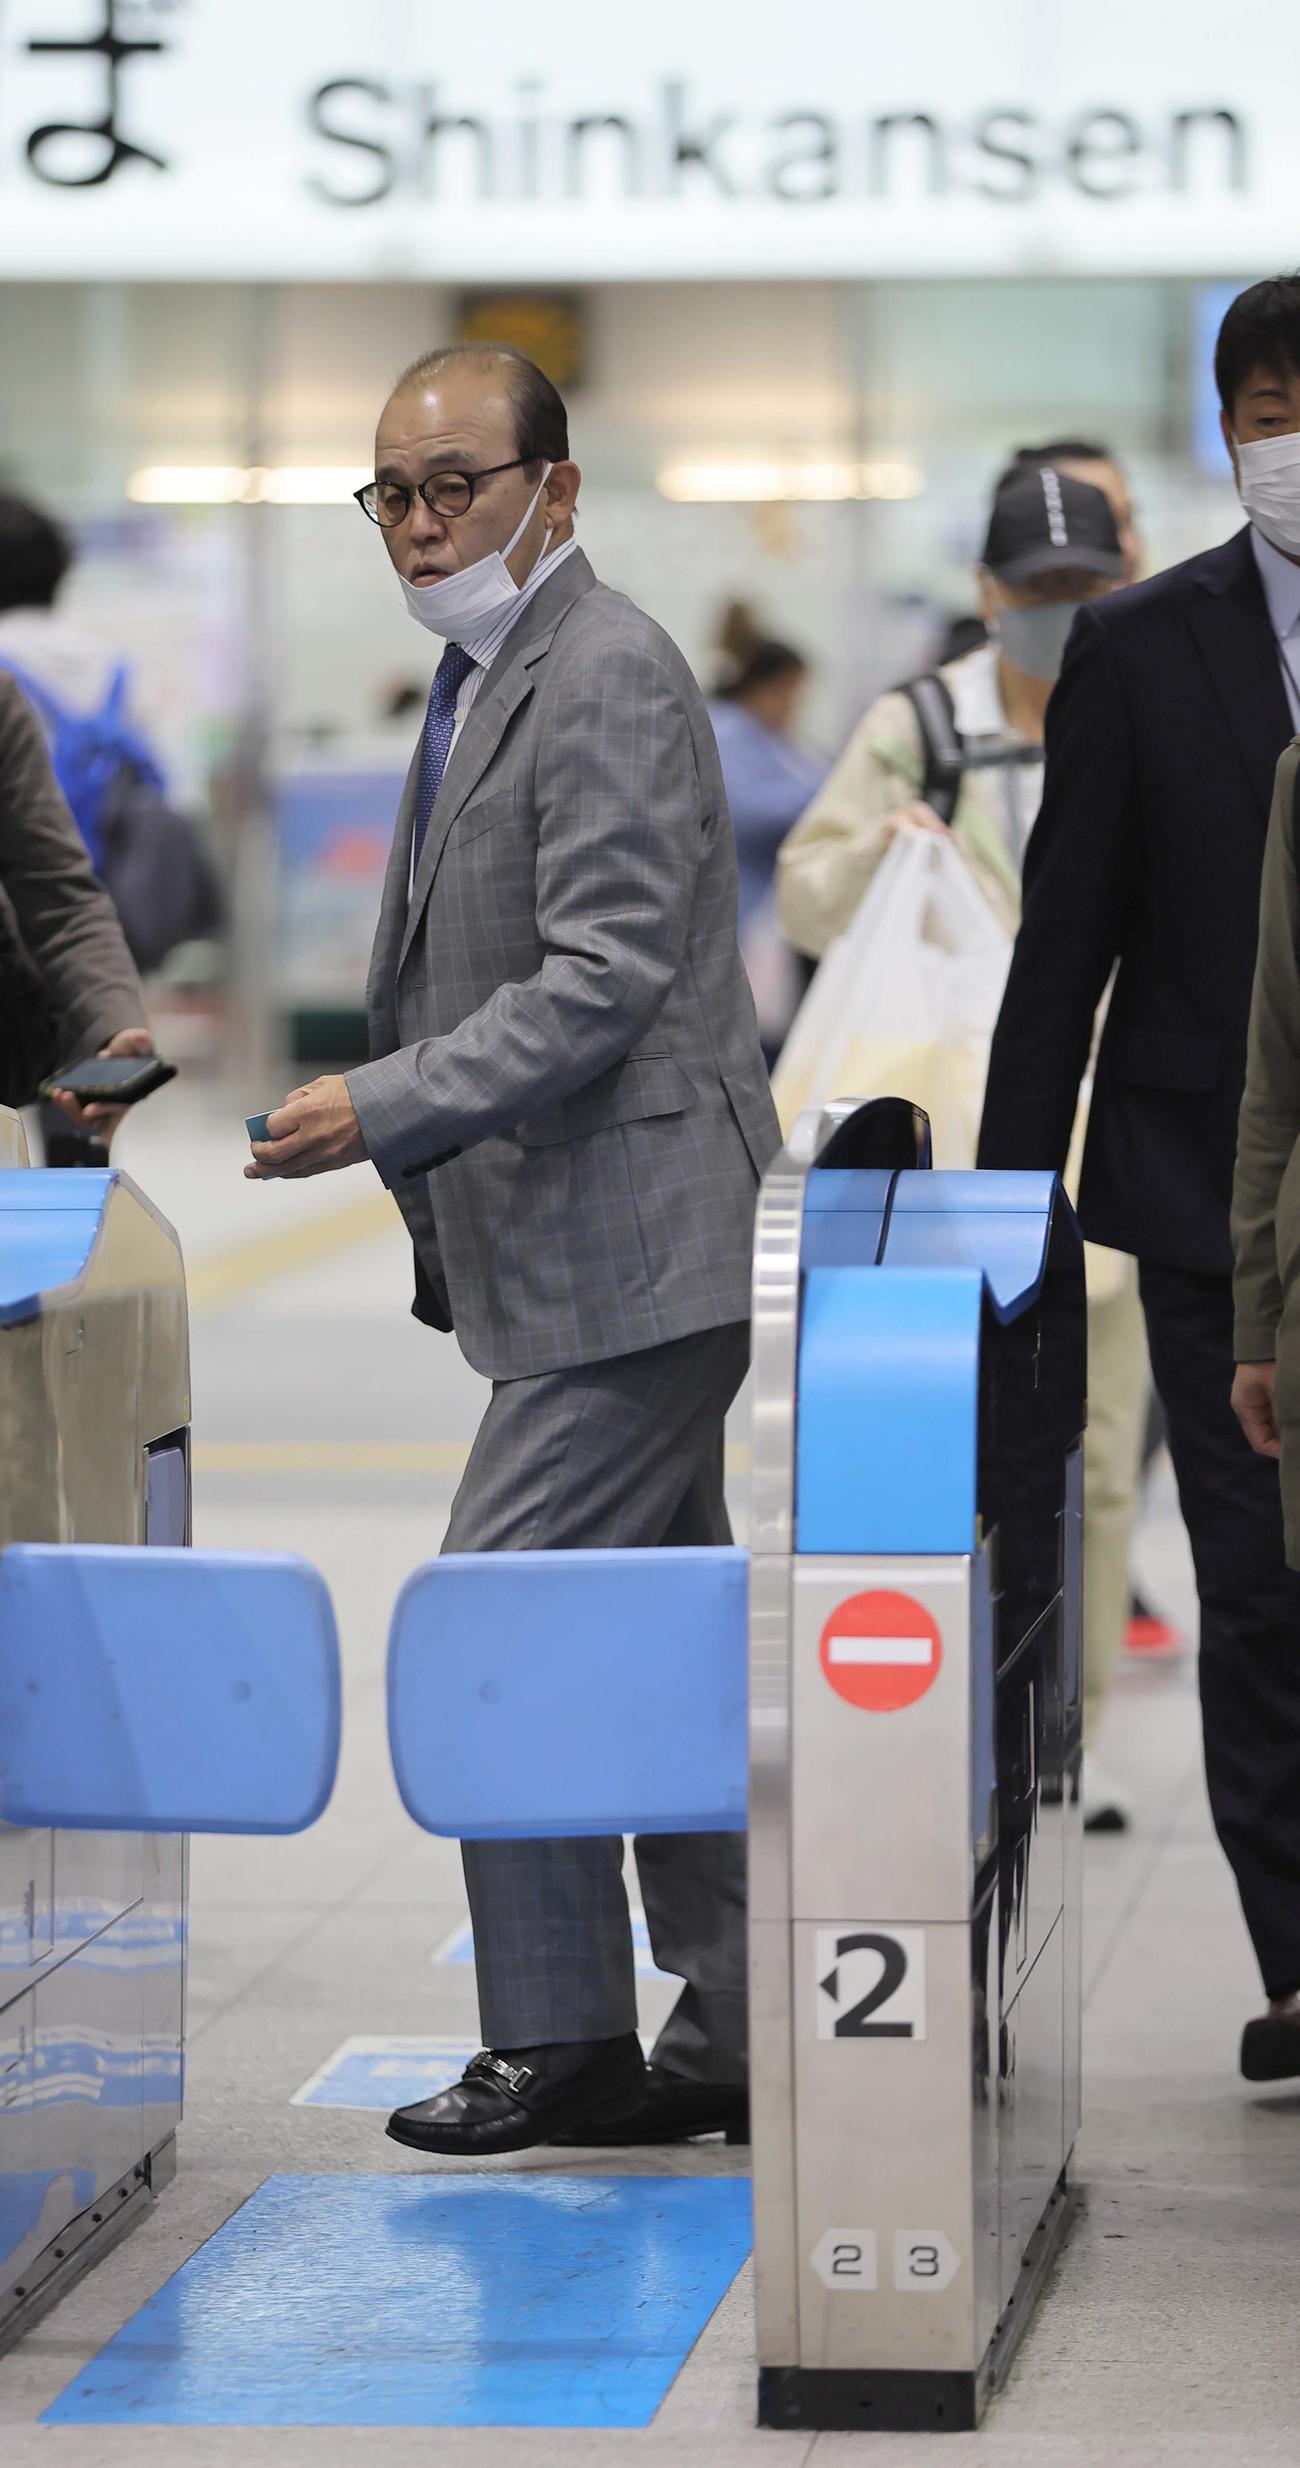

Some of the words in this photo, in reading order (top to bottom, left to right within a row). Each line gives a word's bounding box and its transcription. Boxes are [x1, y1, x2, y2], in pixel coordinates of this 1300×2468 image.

[305, 77, 1246, 208] Shinkansen
[834, 1933, 914, 2038] 2
[832, 2244, 862, 2275] 2
[909, 2245, 939, 2277] 3
